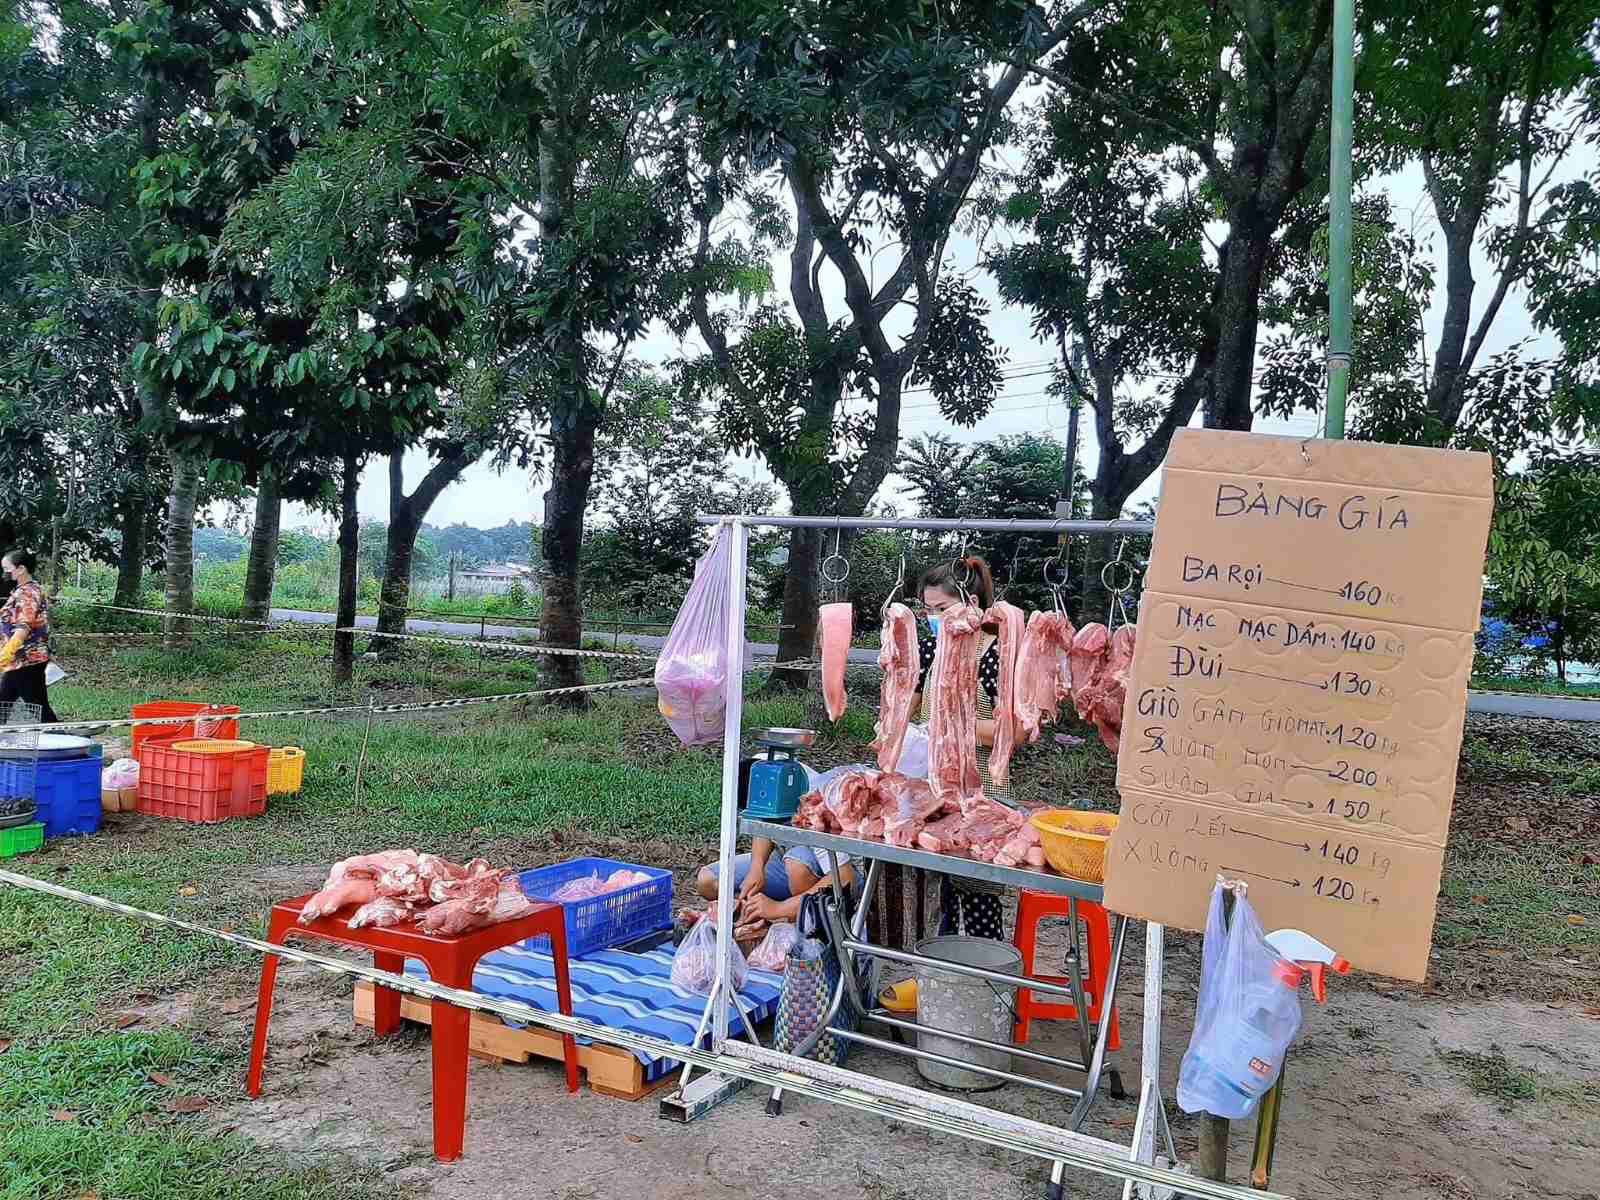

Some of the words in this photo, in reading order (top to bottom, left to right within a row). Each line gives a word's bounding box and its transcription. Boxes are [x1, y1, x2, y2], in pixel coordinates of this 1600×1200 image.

[1215, 482, 1327, 518] BẢNG
[1338, 495, 1409, 530] GIÁ
[1182, 555, 1218, 582] BA
[1344, 580, 1382, 606] 160
[1341, 629, 1376, 652] 140
[1328, 671, 1372, 696] 130
[1331, 723, 1377, 750] 120
[1328, 760, 1377, 786] 200
[1327, 798, 1370, 820] 150
[1320, 840, 1359, 865] 140
[1312, 876, 1354, 901] 120
